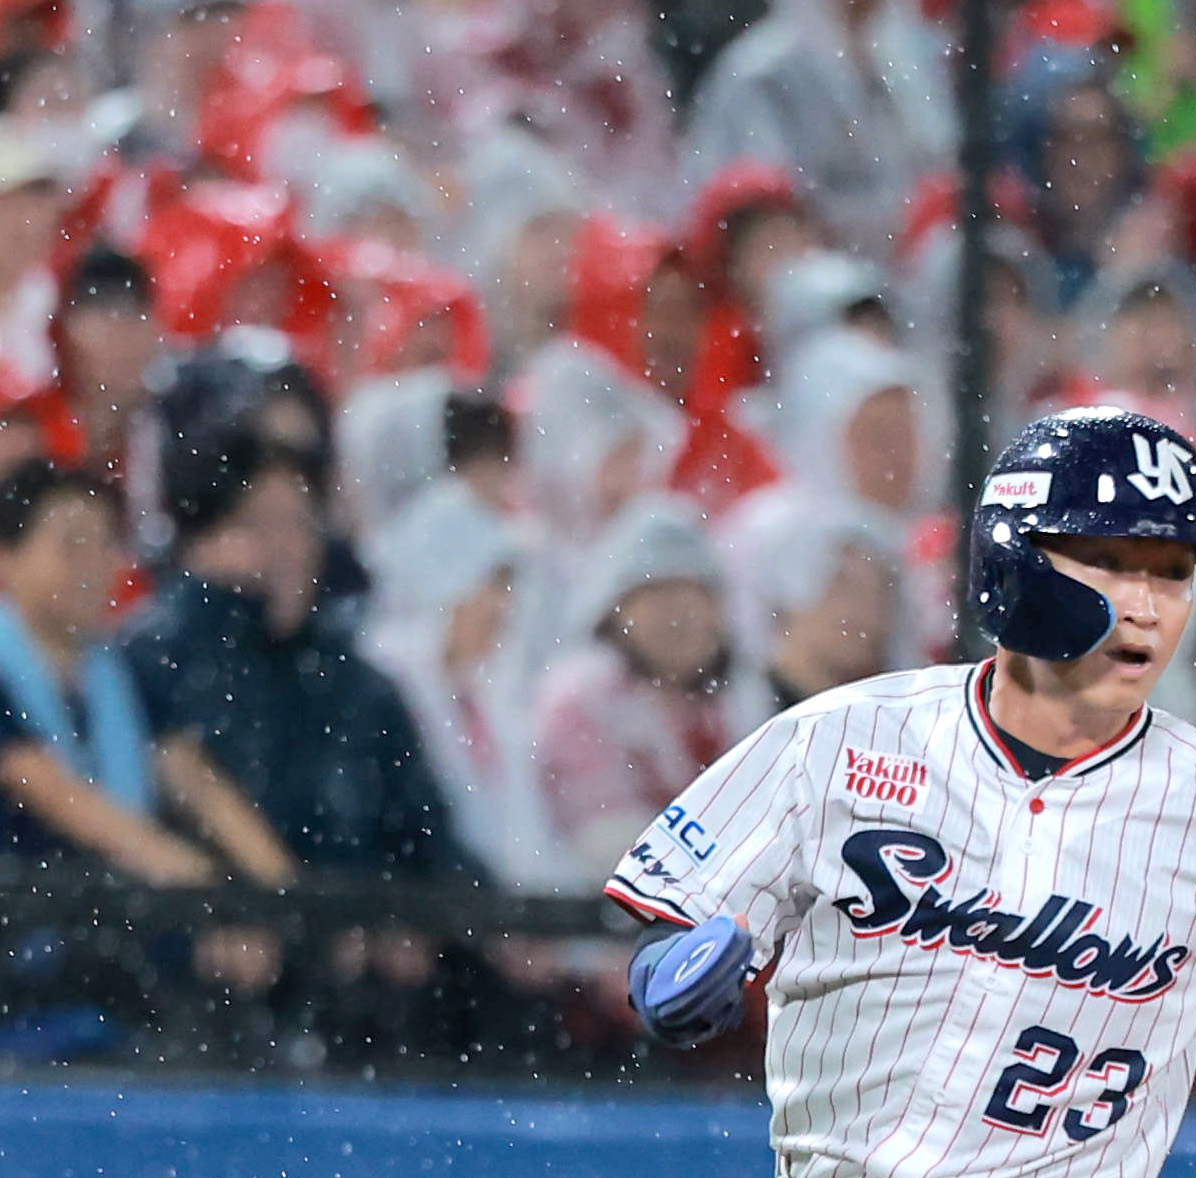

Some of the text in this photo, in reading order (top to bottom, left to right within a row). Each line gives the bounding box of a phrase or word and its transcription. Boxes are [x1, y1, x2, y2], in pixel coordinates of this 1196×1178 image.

[993, 481, 1037, 496] Yakult
[845, 748, 928, 786] Yakult
[844, 772, 918, 807] 1000
[831, 828, 1192, 1004] Swallows
[981, 1024, 1154, 1145] 23
